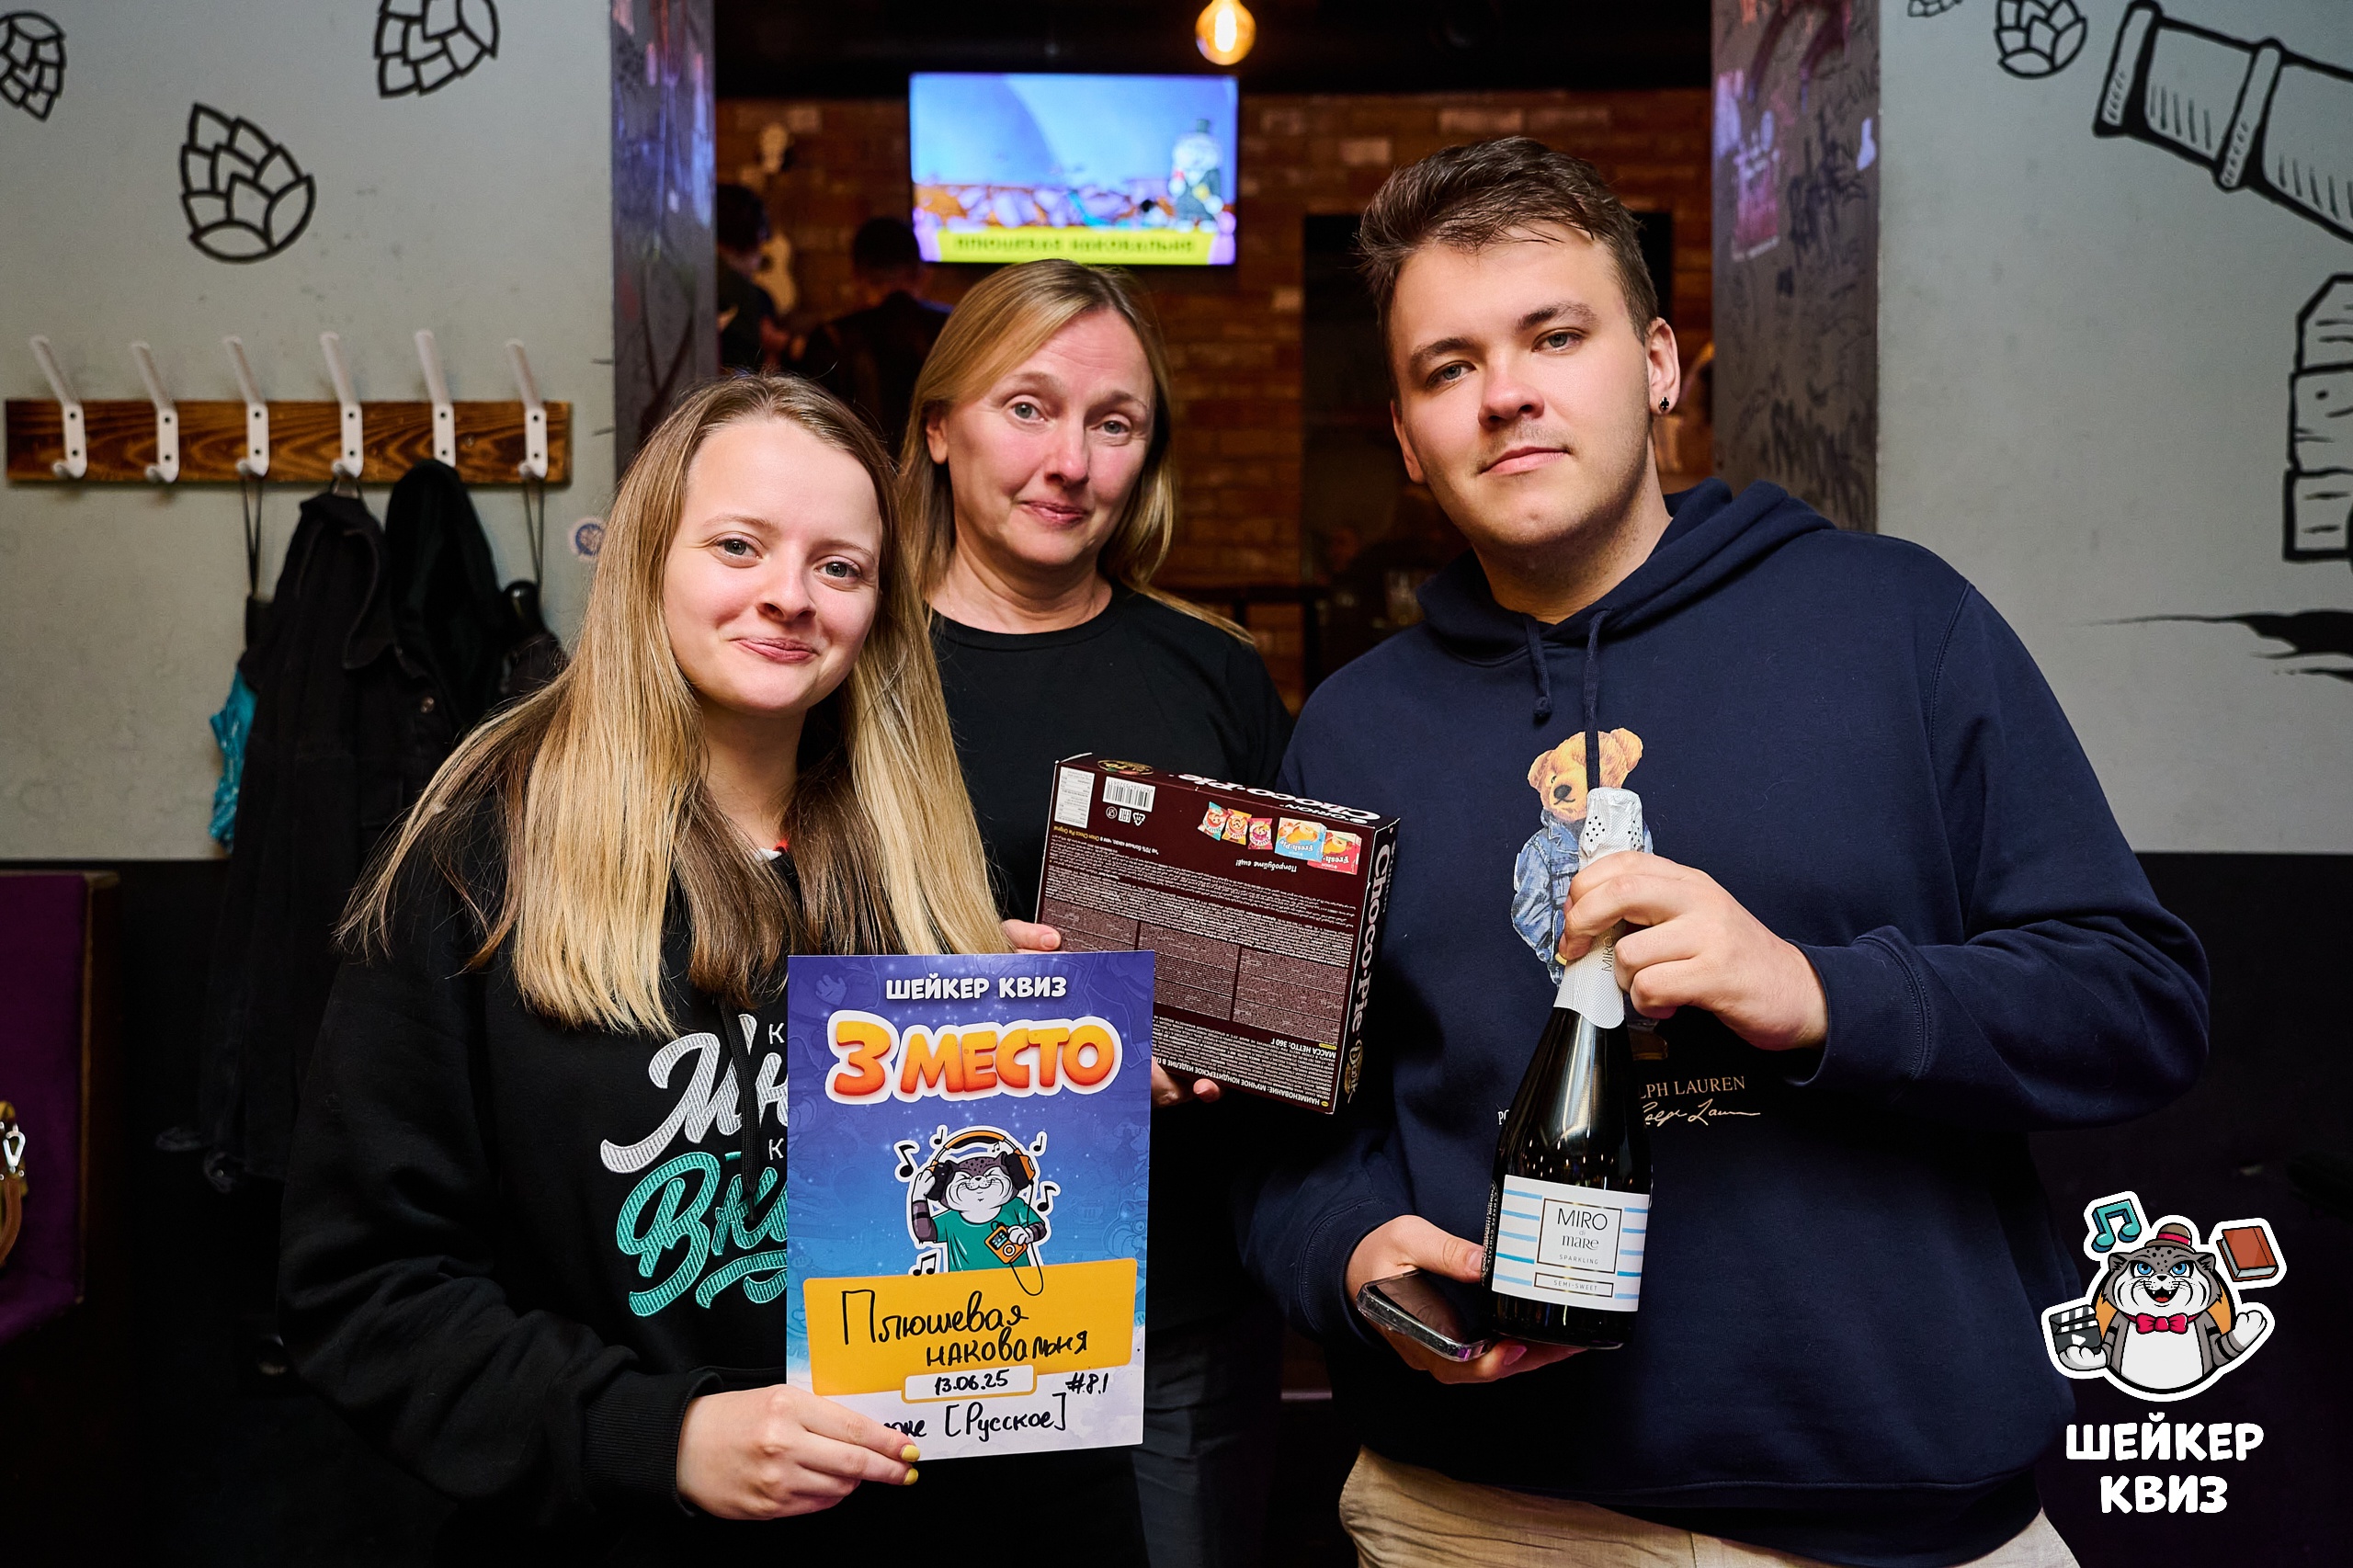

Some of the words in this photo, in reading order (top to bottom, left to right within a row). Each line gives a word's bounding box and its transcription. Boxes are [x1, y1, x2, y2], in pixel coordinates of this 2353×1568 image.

[1253, 860, 1297, 873] Попробуйте
[886, 973, 990, 1000] ШЕЙКЕР
[998, 976, 1067, 998] КВИЗ
[1276, 1039, 1289, 1048] 360
[1288, 1041, 1312, 1052] НЕТТО:
[834, 1020, 892, 1096] 3
[900, 1025, 1115, 1094] МЕСТО
[1313, 1047, 1336, 1059] МАССА
[1167, 1060, 1194, 1072] ИЗДЕЛИЕ
[1194, 1067, 1241, 1085] КОНДИТЕРСКОЕ
[1240, 1079, 1267, 1091] МУЧНОЕ
[1674, 1075, 1745, 1096] LAUREN
[1267, 1085, 1321, 1105] НАИМЕНОВАНИЕ:
[1557, 1208, 1608, 1231] MIRO
[1559, 1254, 1599, 1265] SPARKLING
[1553, 1279, 1598, 1291] SEMI-SWEET
[841, 1289, 1029, 1346] Плюшевая
[926, 1325, 1088, 1367] наковальня
[934, 1369, 1010, 1396] 13.06.25
